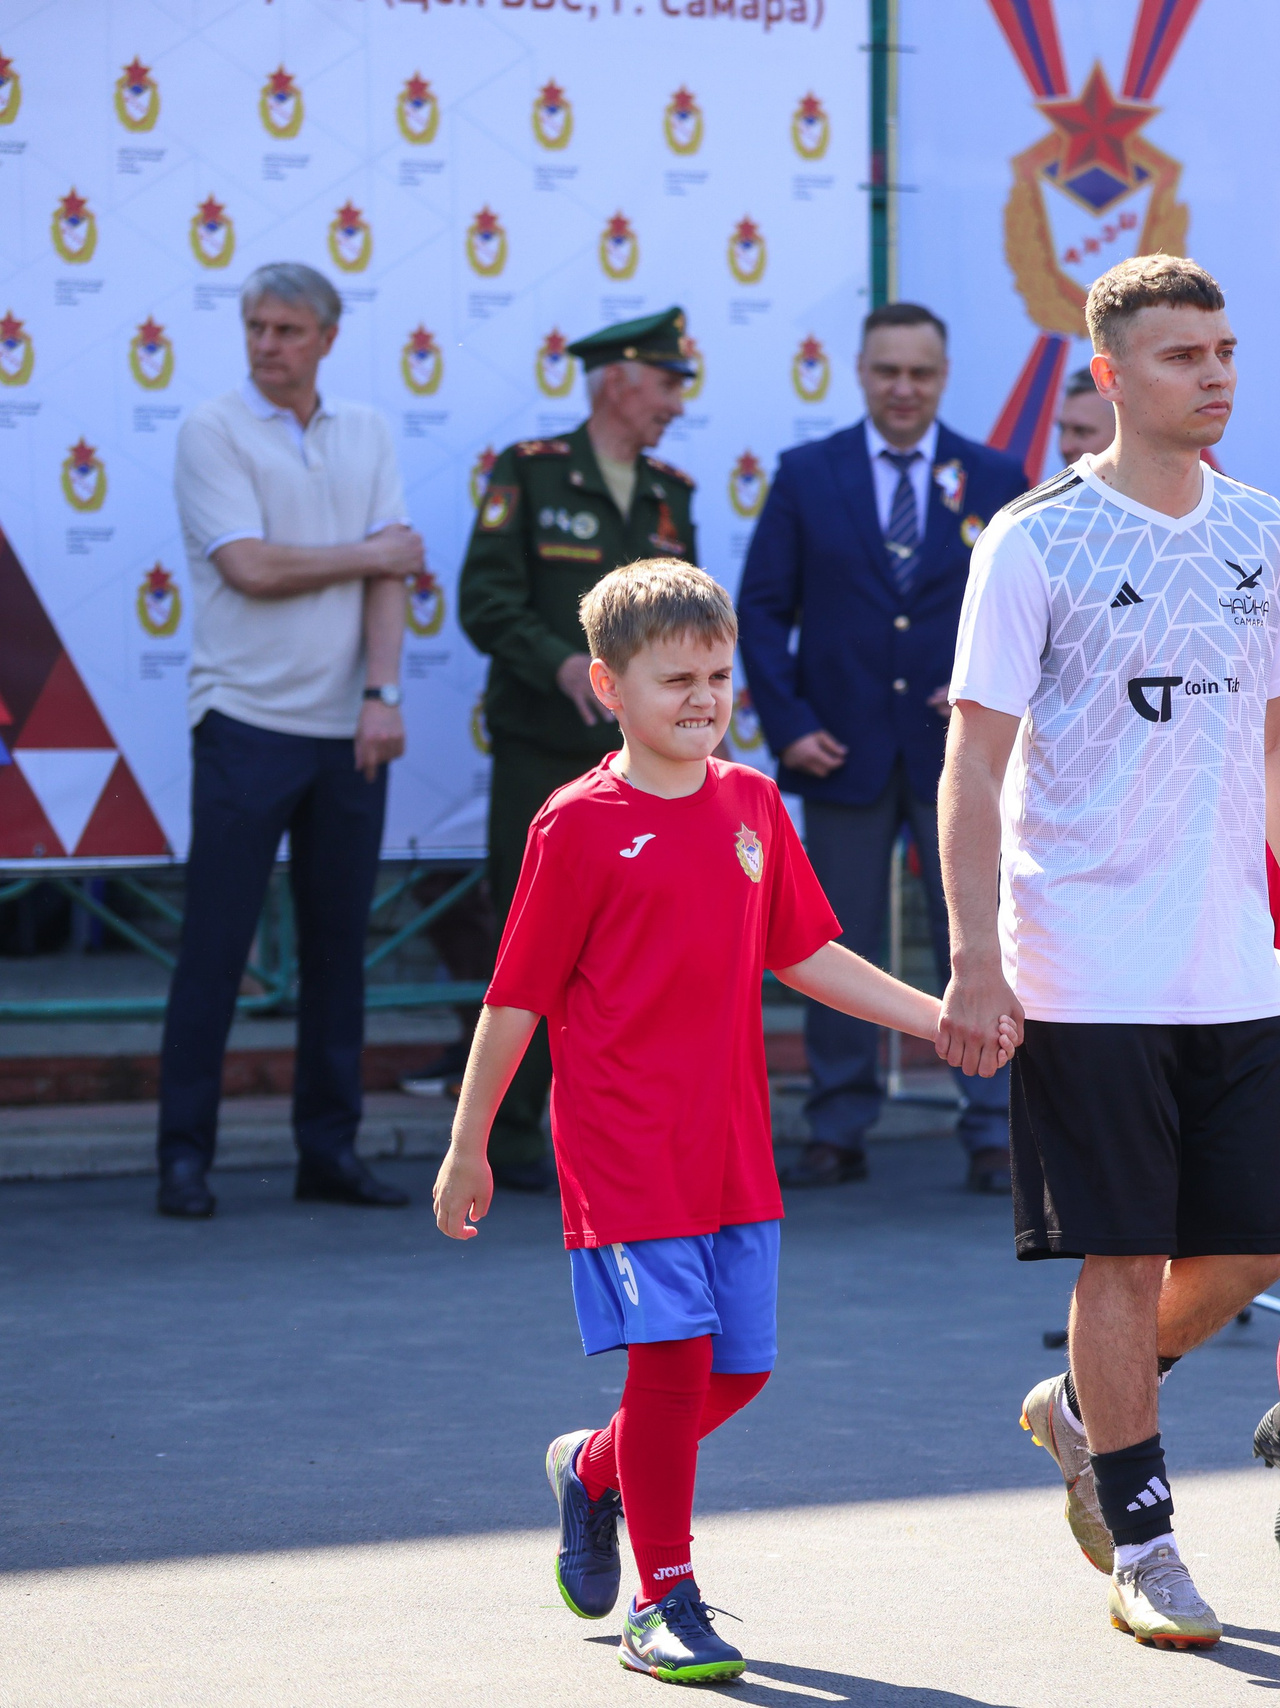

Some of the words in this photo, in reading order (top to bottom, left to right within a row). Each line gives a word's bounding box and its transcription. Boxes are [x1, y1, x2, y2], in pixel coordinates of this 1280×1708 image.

[1218, 594, 1270, 617] ЧАЙКА
[1185, 678, 1219, 696] Coin
[611, 1242, 640, 1307] 5
